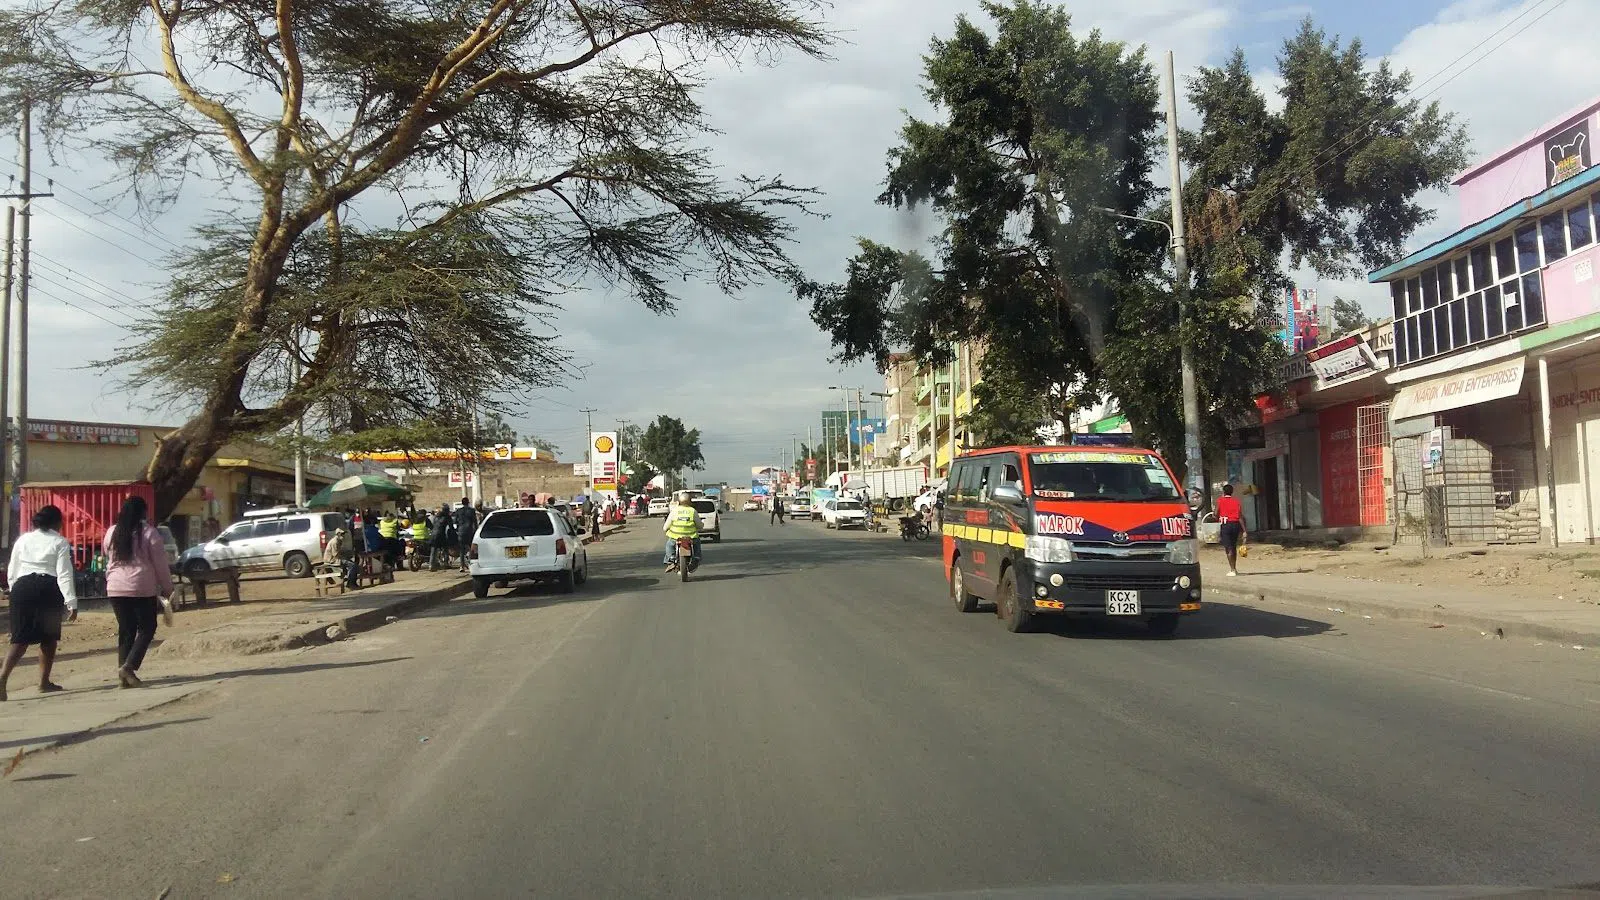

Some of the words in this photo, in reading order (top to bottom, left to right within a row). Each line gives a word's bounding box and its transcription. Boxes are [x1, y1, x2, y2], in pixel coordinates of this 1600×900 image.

[1413, 387, 1439, 404] NAROK
[1441, 380, 1465, 397] NIDHI
[1464, 367, 1519, 393] ENTERPRISES
[70, 426, 137, 437] ELECTRICALS
[1037, 514, 1085, 535] NAROK
[1161, 516, 1191, 537] LINE
[1110, 591, 1131, 602] KCX
[1109, 602, 1137, 613] 612R
